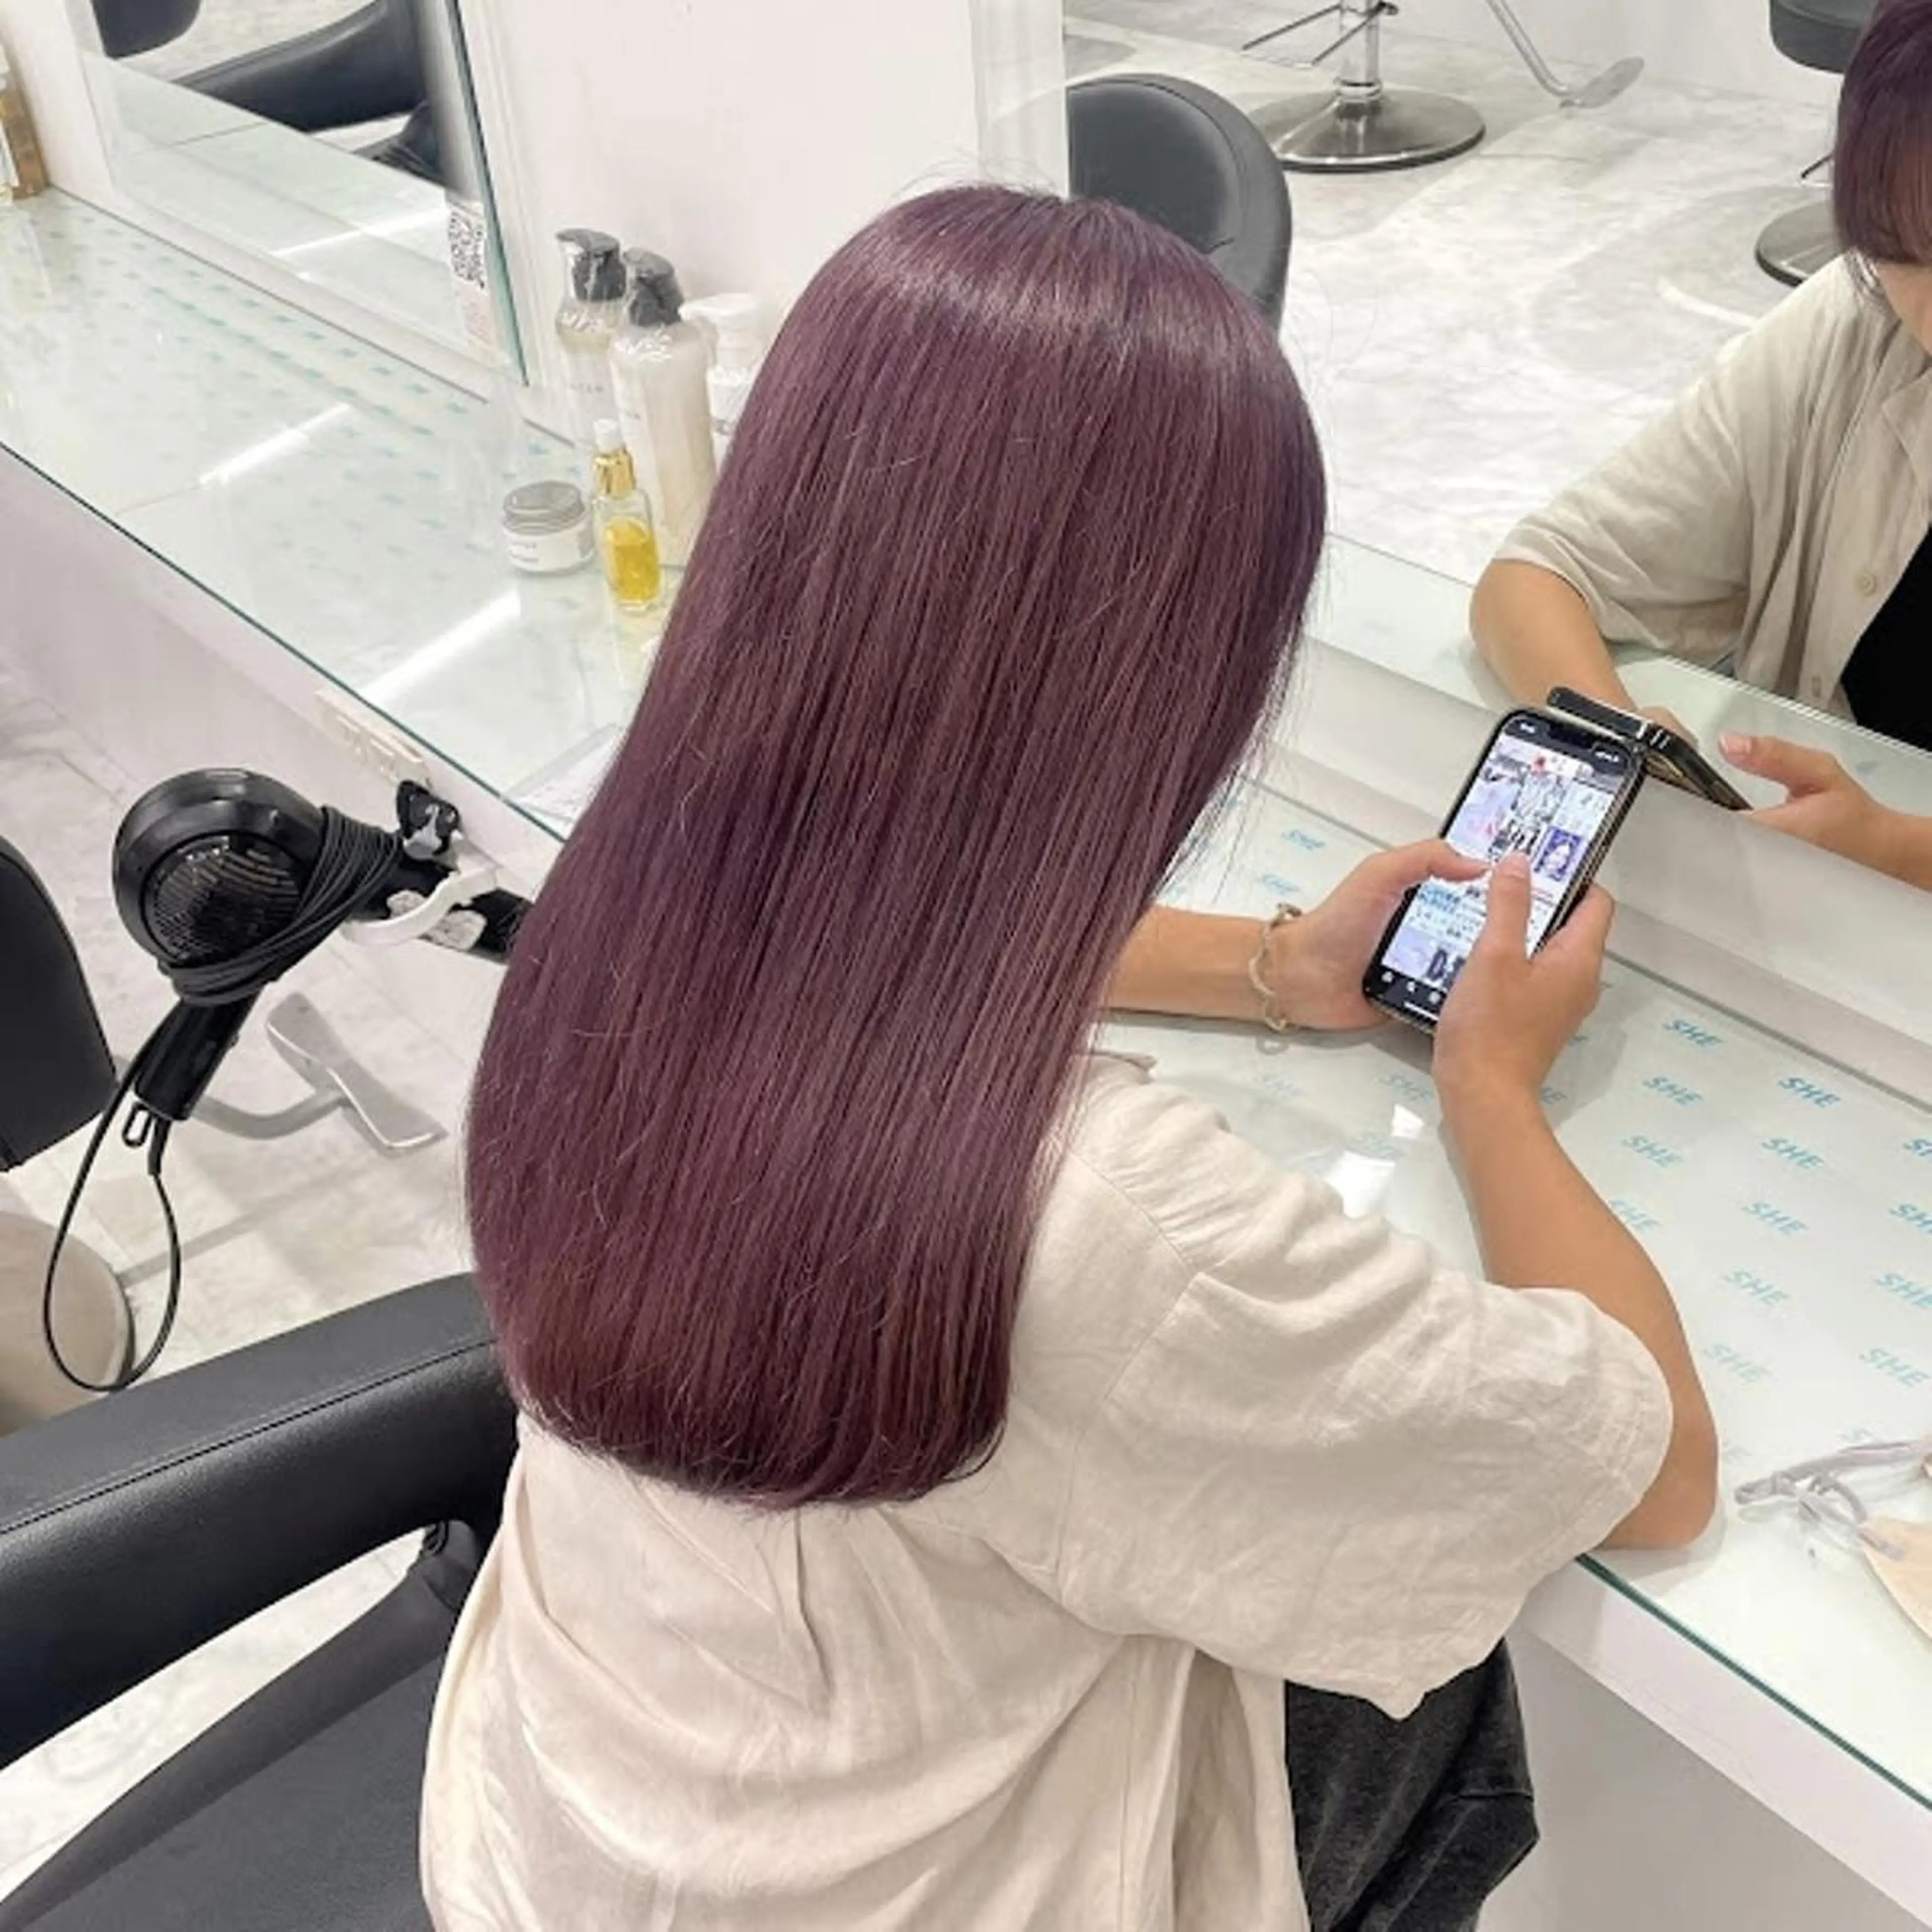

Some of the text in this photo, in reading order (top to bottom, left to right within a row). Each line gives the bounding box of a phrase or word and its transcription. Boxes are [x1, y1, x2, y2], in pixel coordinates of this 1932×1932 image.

[1663, 1018, 1725, 1048] SHE
[1643, 1075, 1703, 1107] SHE
[1778, 1077, 1840, 1108] SHE
[1622, 1135, 1682, 1167] SHE
[1762, 1138, 1824, 1170] SHE
[1742, 1201, 1808, 1235] SHE
[1888, 1203, 1932, 1236] SH
[1721, 1270, 1789, 1306] SHE
[1859, 1348, 1930, 1387] SHE
